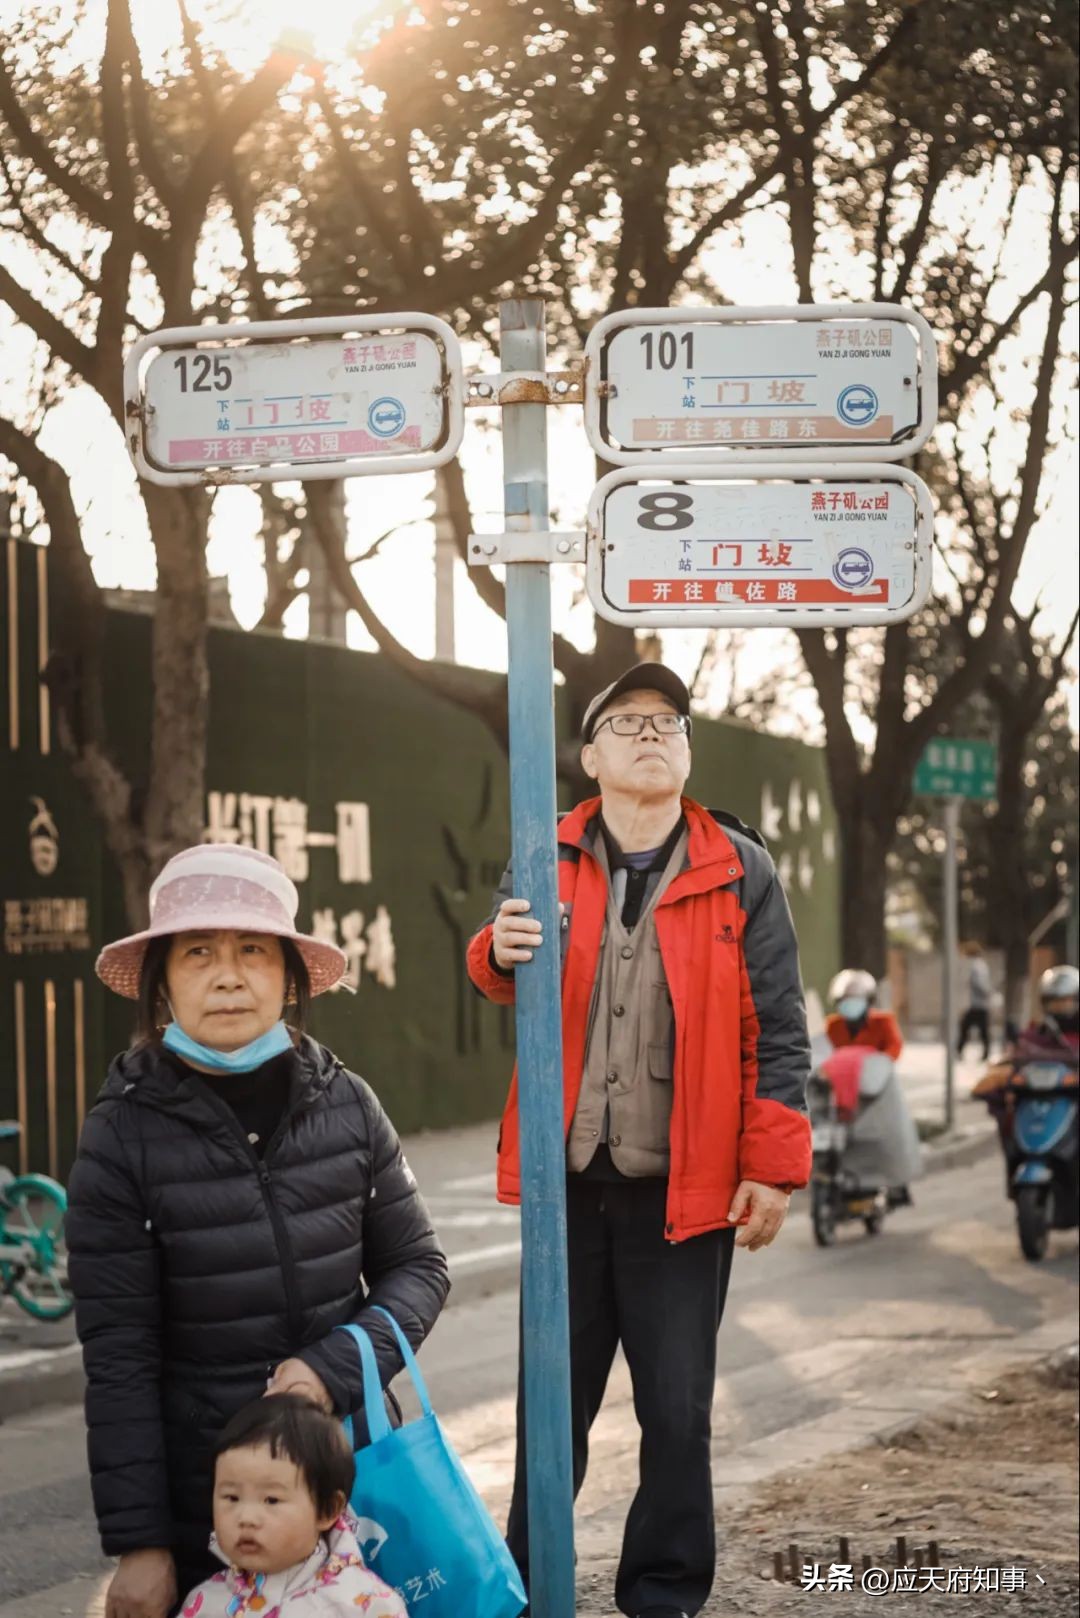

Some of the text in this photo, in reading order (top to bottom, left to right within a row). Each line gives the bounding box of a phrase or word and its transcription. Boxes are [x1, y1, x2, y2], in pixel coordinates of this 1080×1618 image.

[816, 328, 892, 347] 燕子矶公园
[343, 342, 416, 364] 燕子矶公园
[640, 331, 694, 370] 101
[818, 349, 891, 358] YAN ZI JI GONG YUAN
[174, 354, 232, 393] 125
[375, 363, 396, 371] GONG
[397, 361, 416, 369] YUAN
[682, 376, 696, 409] 下站
[716, 380, 806, 403] 门坡
[216, 400, 230, 431] 下站
[656, 419, 817, 439] 开往尧佳路东
[637, 491, 694, 531] 8
[811, 491, 889, 511] 燕子矶公园
[814, 512, 888, 521] YAN ZI JI GONG YUAN
[678, 540, 692, 572] 下站
[712, 543, 792, 567] 门坡
